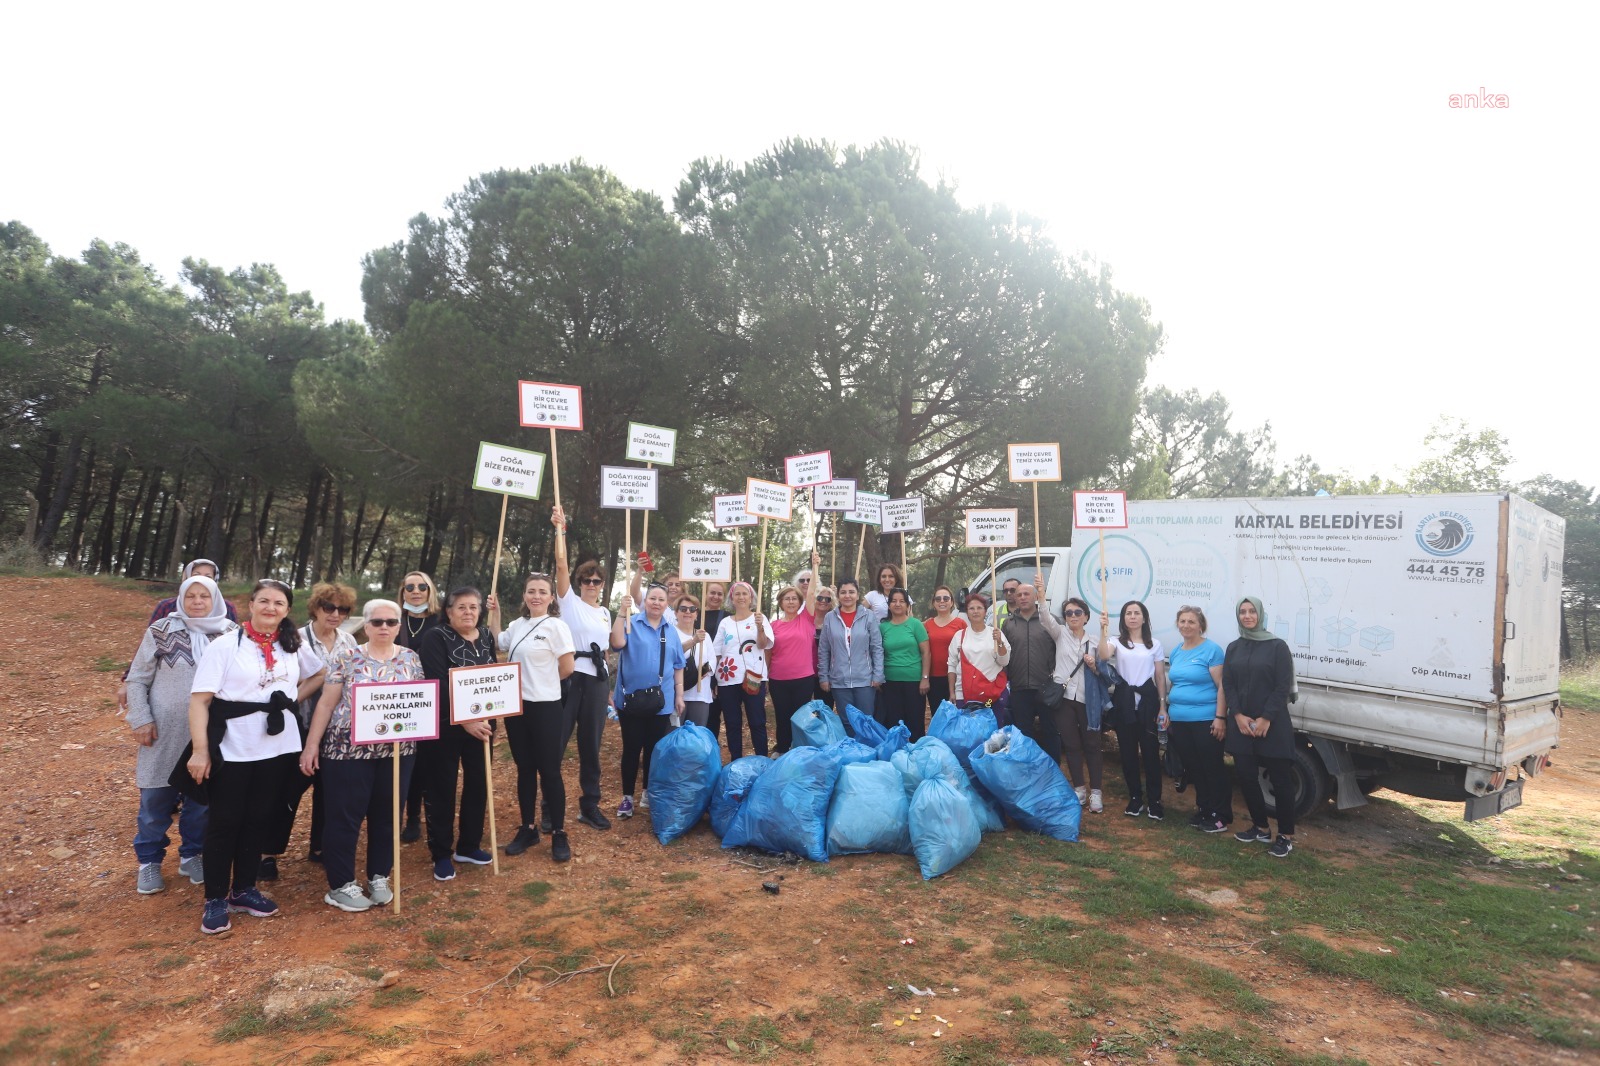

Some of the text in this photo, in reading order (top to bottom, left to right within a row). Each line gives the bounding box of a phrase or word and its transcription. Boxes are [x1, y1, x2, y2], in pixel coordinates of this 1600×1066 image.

[500, 456, 523, 465] DOĞA
[484, 461, 536, 476] BİZE EMANET
[1156, 516, 1194, 525] TOPLAMA
[1196, 516, 1223, 525] ARACI
[1235, 511, 1403, 529] KARTAL BELEDİYESİ
[1416, 511, 1473, 533] KARTAL BELEDİYESİ
[1112, 567, 1133, 576] SIFIR
[1407, 564, 1485, 577] 444 45 78
[1156, 588, 1211, 598] DESTEKLİYORUM
[1320, 656, 1334, 664] çöp
[1336, 657, 1368, 667] değildir.
[1411, 666, 1471, 680] Çöp Atılmaz!
[458, 673, 514, 686] YERLERE ÇÖP
[473, 686, 501, 695] ATMA!
[371, 693, 397, 701] İSRAF
[362, 701, 432, 711] KAYNAKLARINI
[384, 712, 411, 720] KORU!
